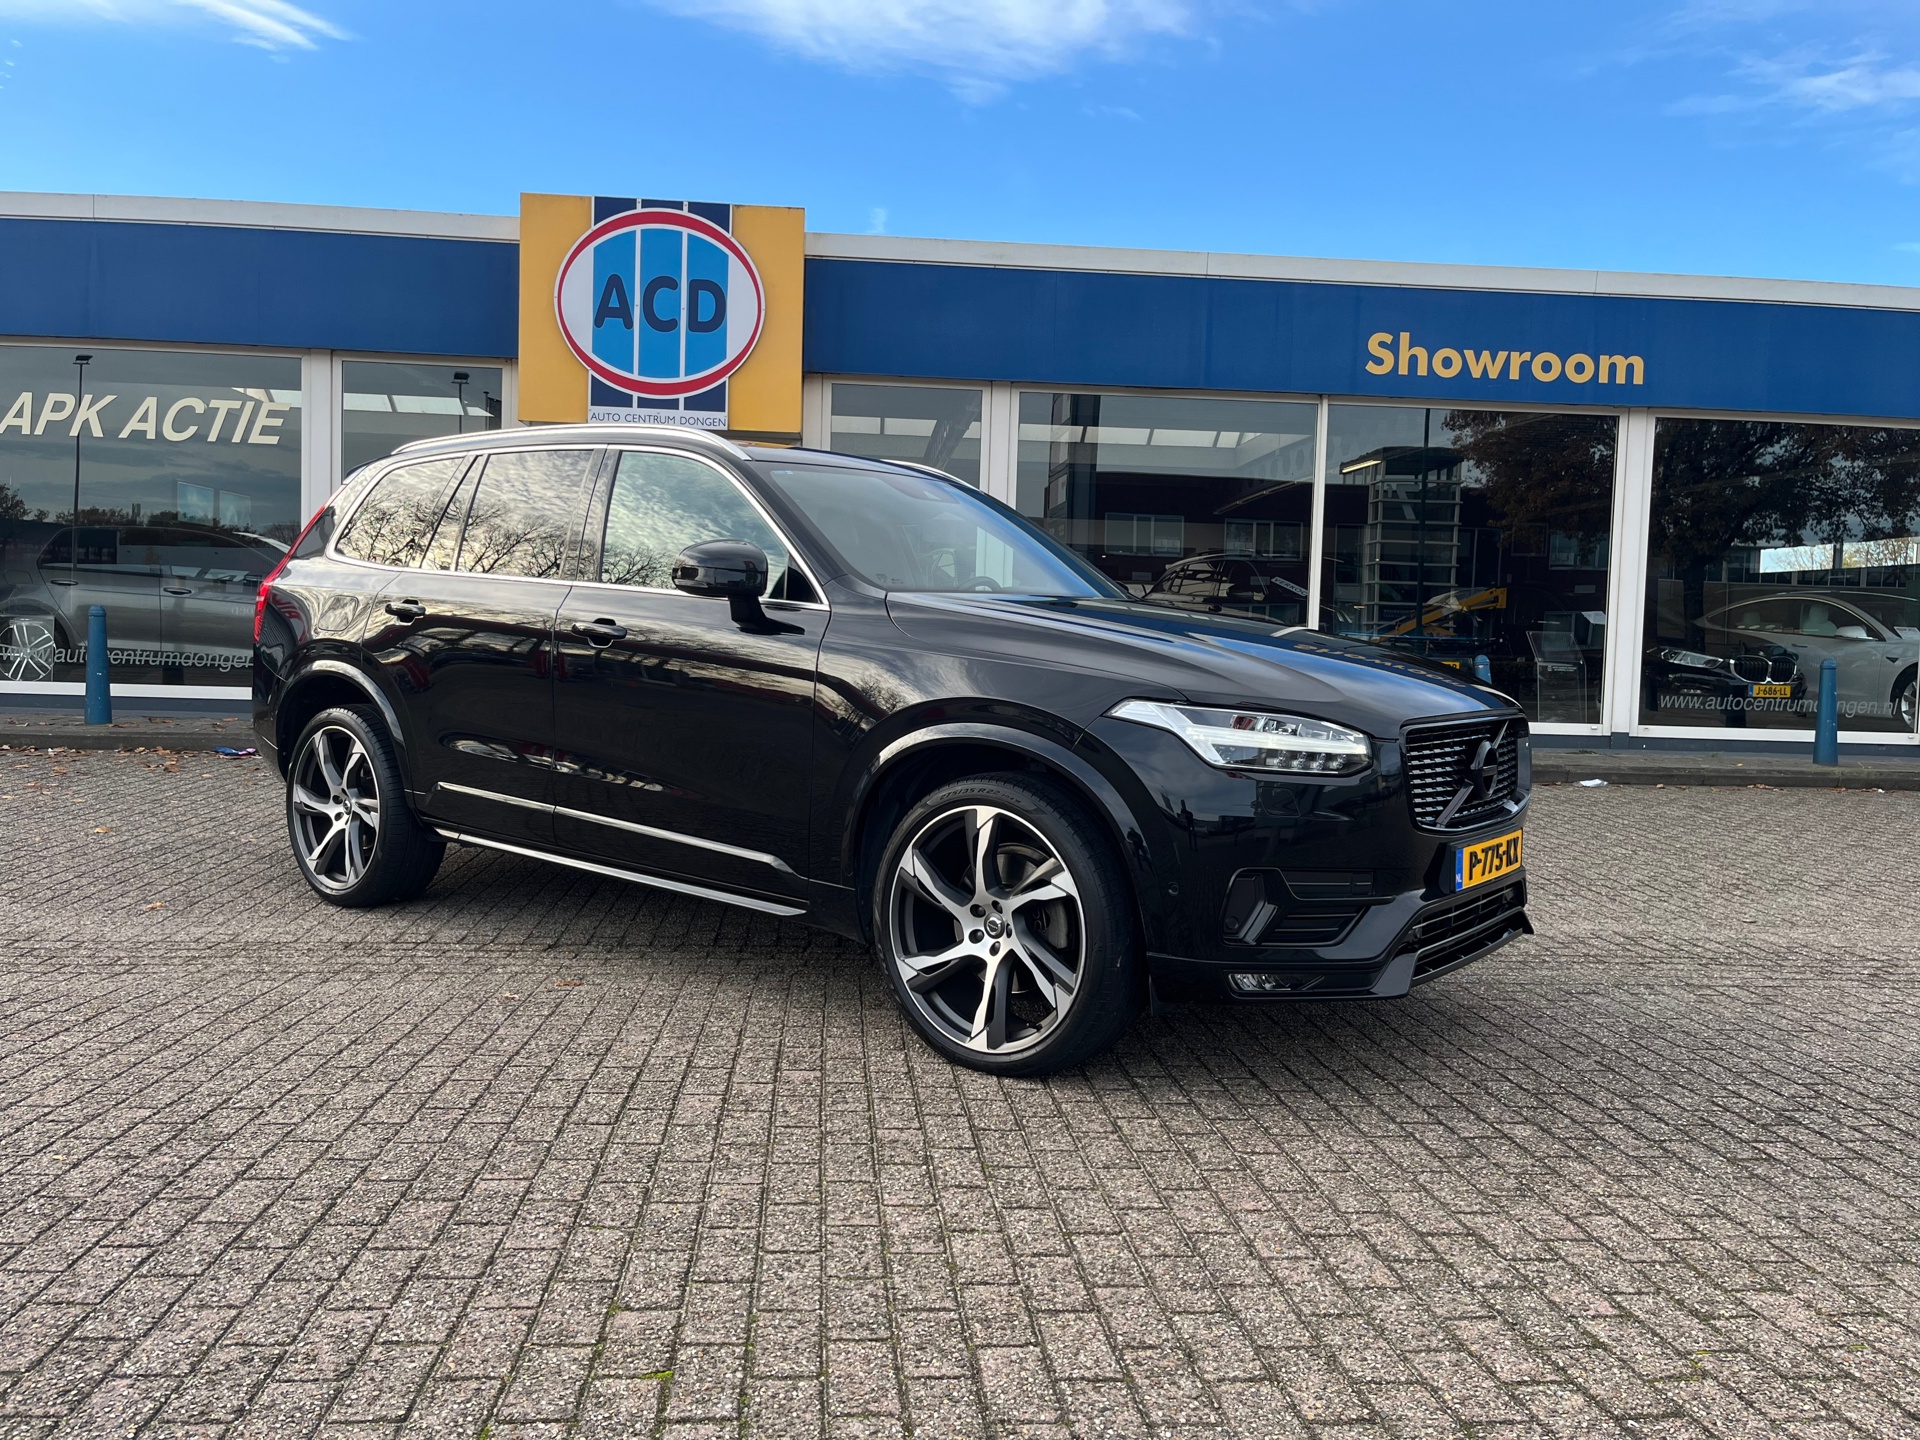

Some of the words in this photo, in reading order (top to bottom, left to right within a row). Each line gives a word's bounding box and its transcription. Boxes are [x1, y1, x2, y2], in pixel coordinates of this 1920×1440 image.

[594, 273, 727, 333] ACD
[1365, 331, 1645, 385] Showroom
[0, 391, 118, 438] APK
[118, 397, 292, 445] ACTIE
[590, 411, 621, 422] AUTO
[624, 413, 676, 425] CENTRUM
[679, 416, 727, 427] DONGEN
[2, 646, 254, 673] www.autentrumdonge
[1756, 686, 1788, 696] J-686-LL
[1660, 693, 1900, 719] www.autocentrumngen.nl
[939, 787, 976, 801] 275/35
[1468, 836, 1519, 882] P-775-KX
[1455, 873, 1462, 883] NL
